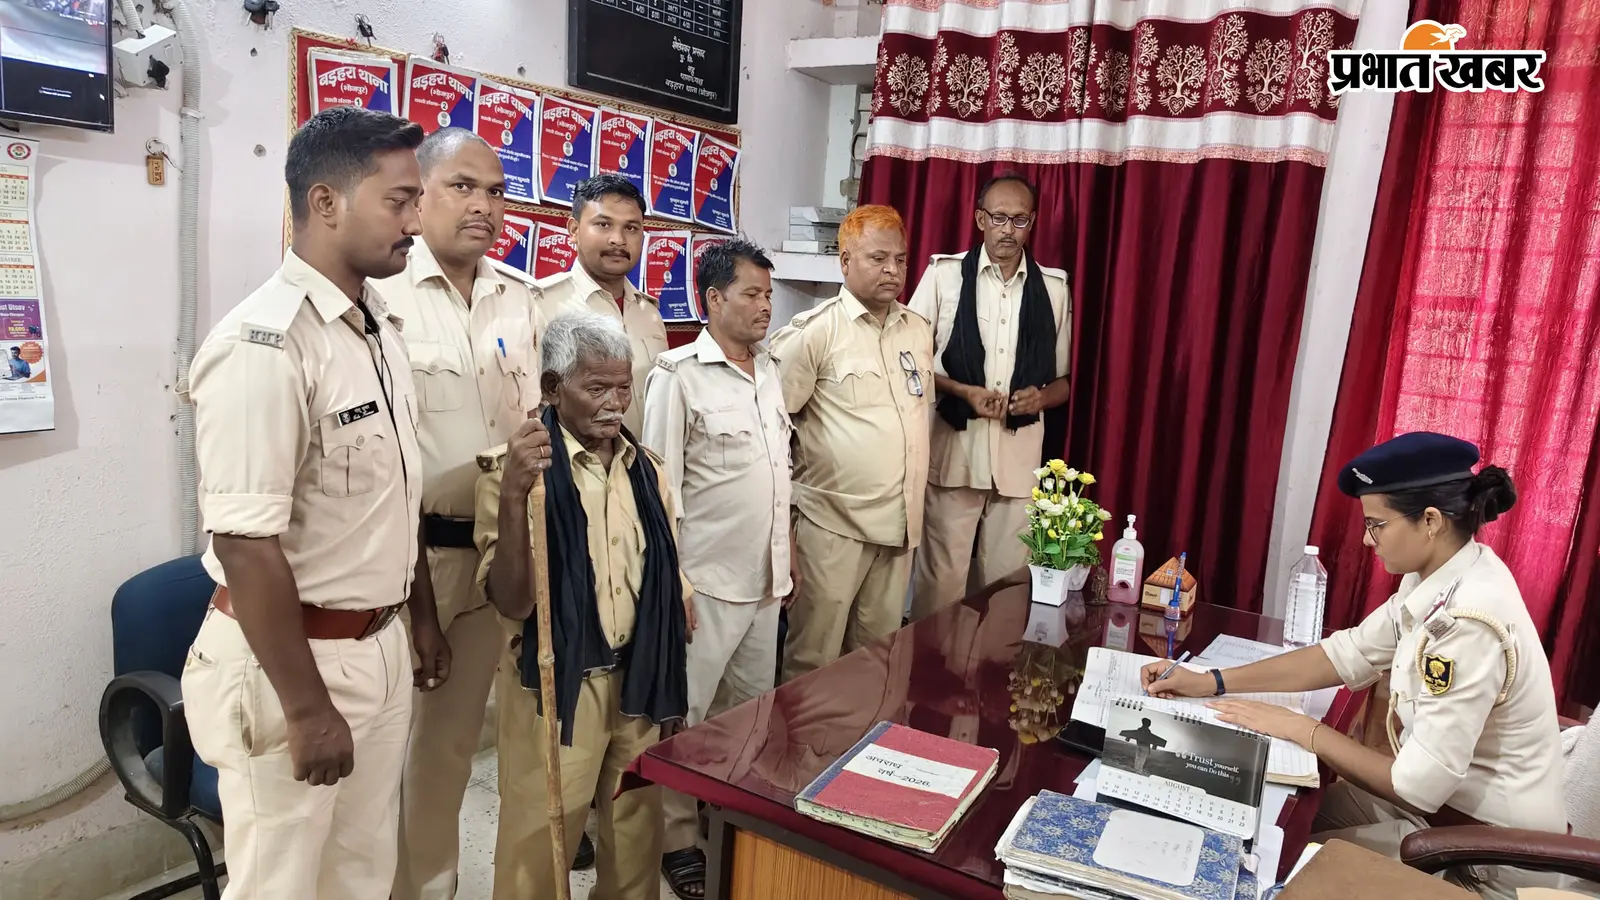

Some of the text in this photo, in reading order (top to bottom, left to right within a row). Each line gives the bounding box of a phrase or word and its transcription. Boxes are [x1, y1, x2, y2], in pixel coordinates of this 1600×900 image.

[319, 66, 389, 94] बड़हरा थाना
[412, 72, 474, 102] बड़हरा थाना
[479, 92, 532, 121] बड़हरा थाना
[543, 107, 570, 121] बड़हरा
[571, 110, 592, 133] थाना
[601, 118, 645, 140] बड़हरा थाना
[676, 132, 693, 153] थाना
[720, 150, 733, 170] थाना
[505, 224, 527, 248] थाना
[539, 234, 568, 249] बड़हरा
[668, 239, 685, 256] थाना
[1189, 752, 1213, 766] Trust
[1164, 780, 1190, 792] AUGUST
